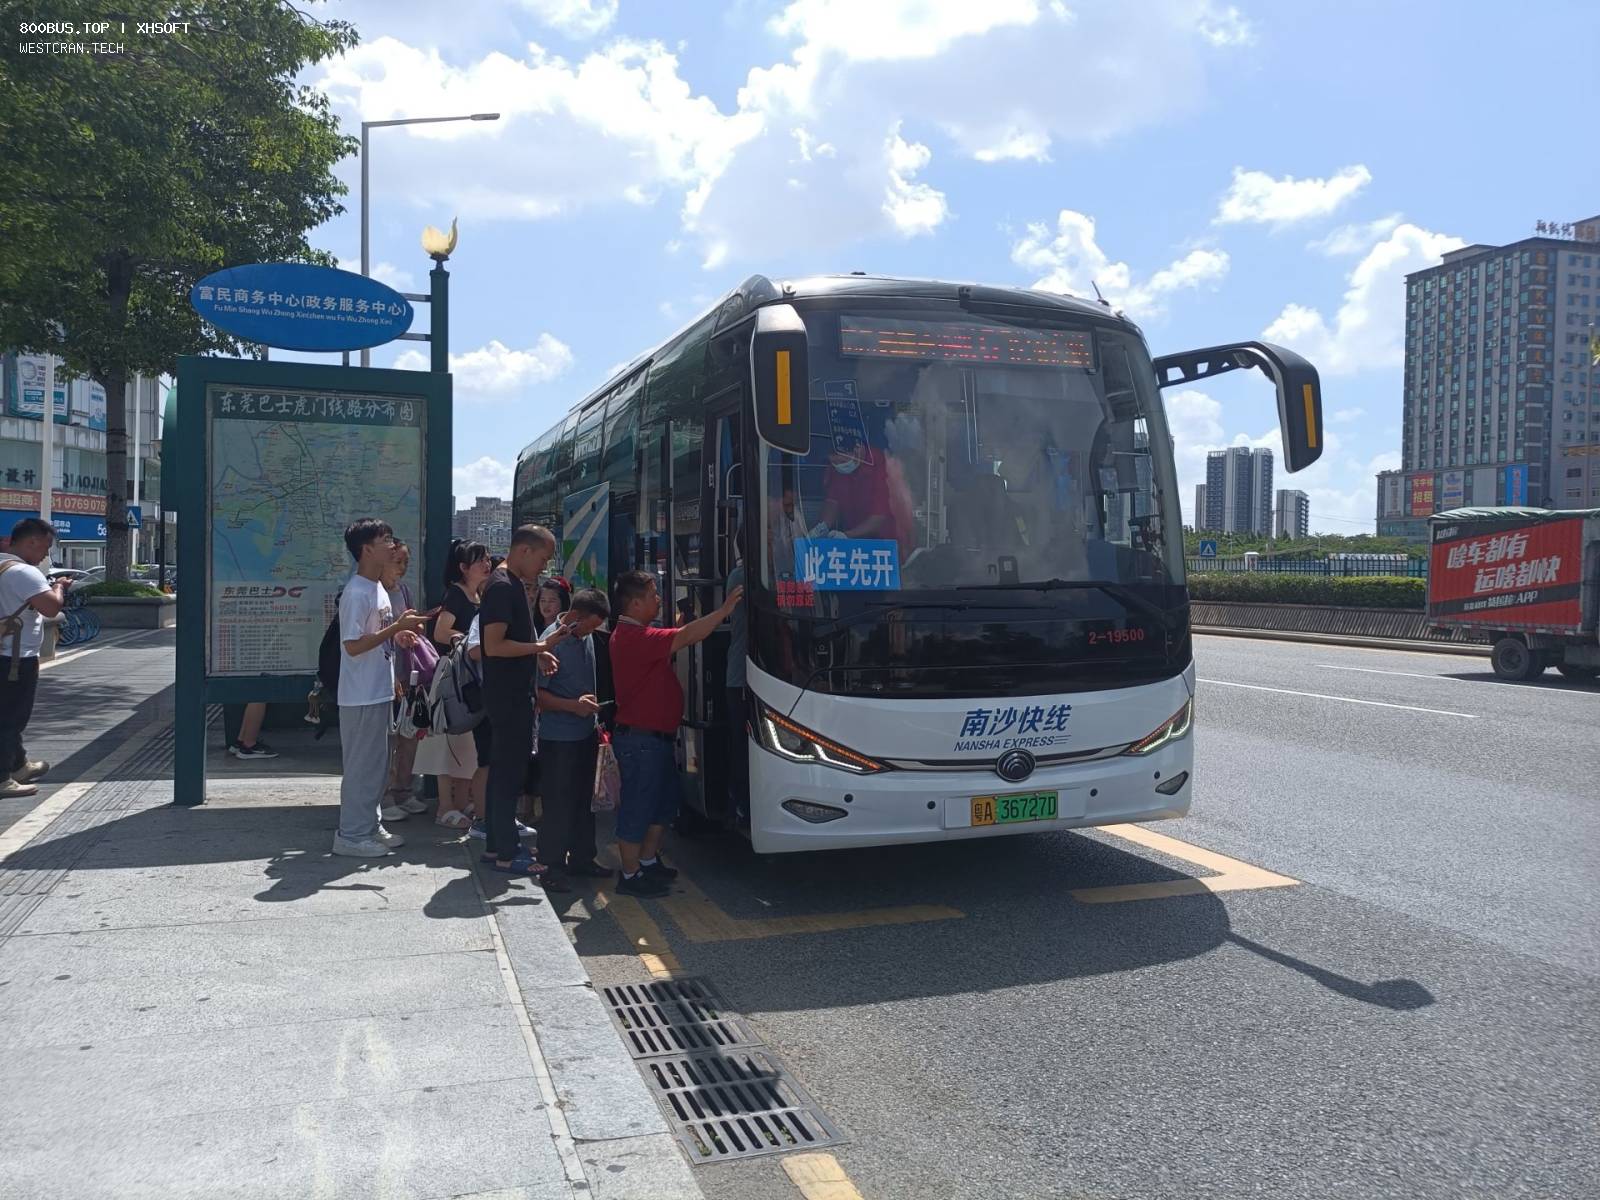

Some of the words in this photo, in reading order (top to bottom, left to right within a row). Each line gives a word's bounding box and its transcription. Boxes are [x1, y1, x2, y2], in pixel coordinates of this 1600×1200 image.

[199, 285, 407, 317] 富民商务中心(政务服务中心)
[224, 305, 238, 313] Min
[239, 306, 260, 316] Shang
[220, 391, 414, 421] 东莞巴士虎门线路分布图
[0, 467, 37, 486] 设计
[804, 547, 894, 587] 此车先开
[1446, 533, 1530, 570] 啥车都有
[1473, 555, 1562, 593] 运啥都快
[1088, 628, 1145, 645] 2-19500
[959, 704, 1072, 738] 南沙快线
[954, 738, 1001, 752] NANSHA
[1002, 735, 1056, 749] EXPRESS
